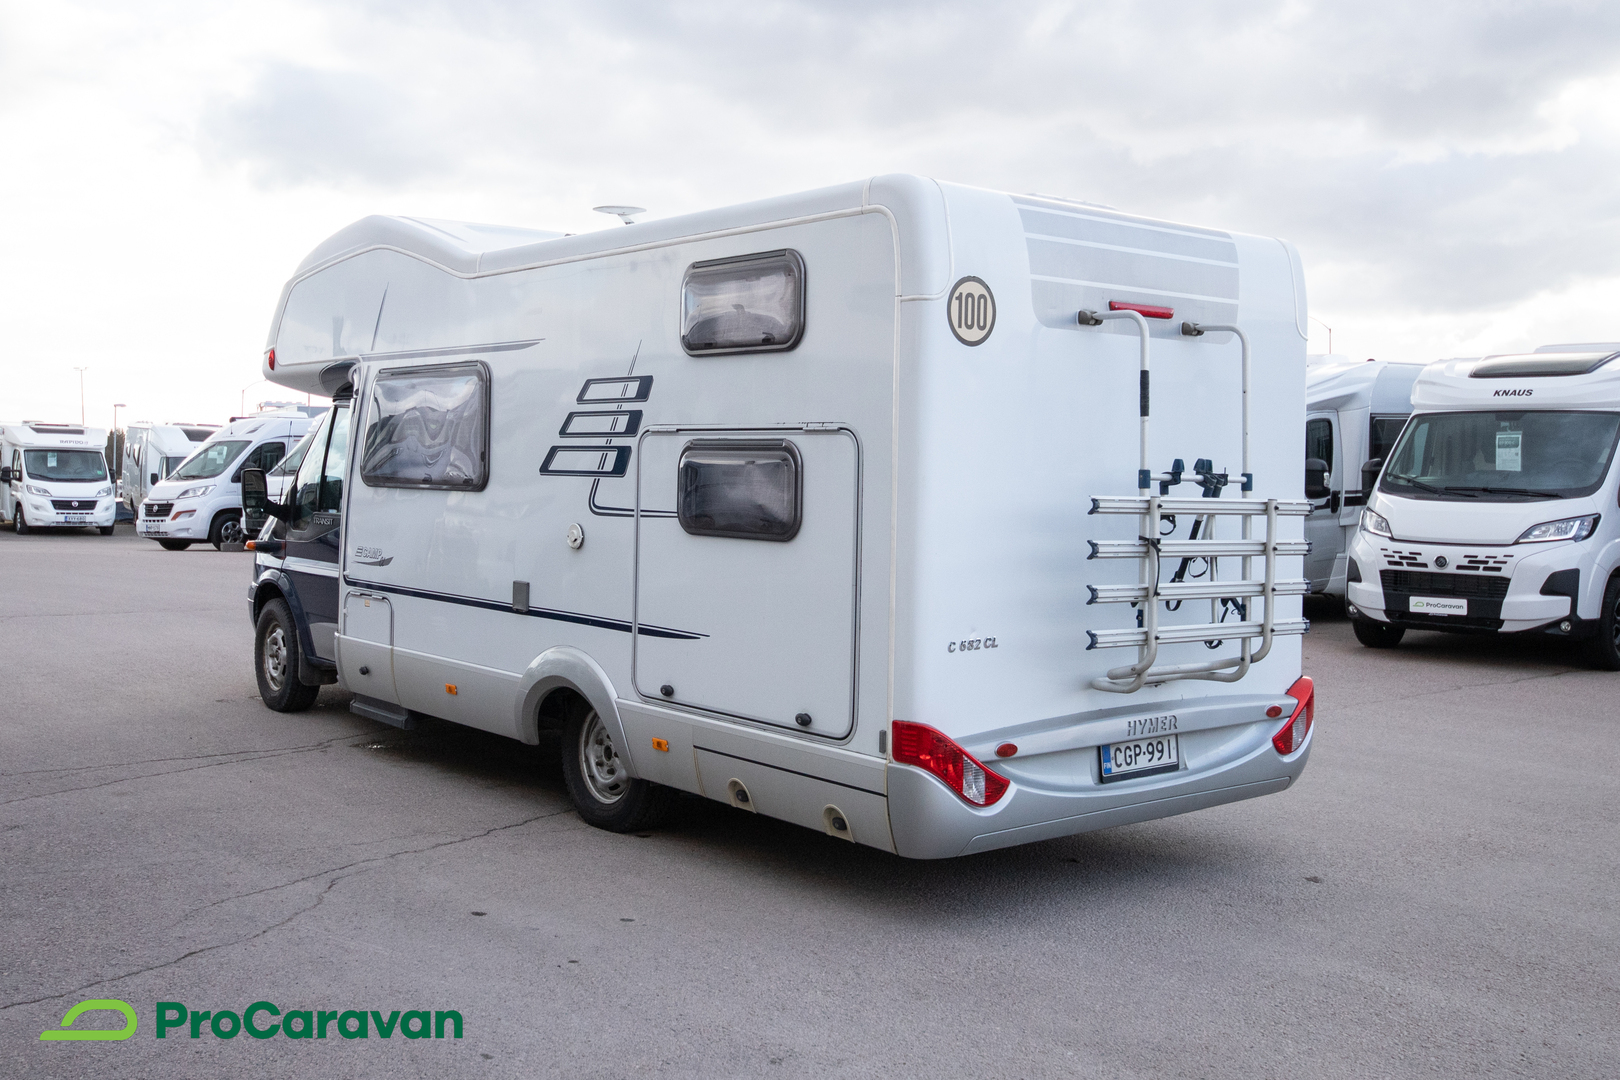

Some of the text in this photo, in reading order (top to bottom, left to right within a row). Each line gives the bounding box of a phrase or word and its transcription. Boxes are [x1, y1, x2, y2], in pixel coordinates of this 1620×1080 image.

[955, 292, 987, 331] 100
[313, 517, 333, 525] TRANSIT
[948, 637, 998, 653] C 682 CL
[1127, 714, 1178, 737] HYMER
[1114, 738, 1171, 768] CGP-991
